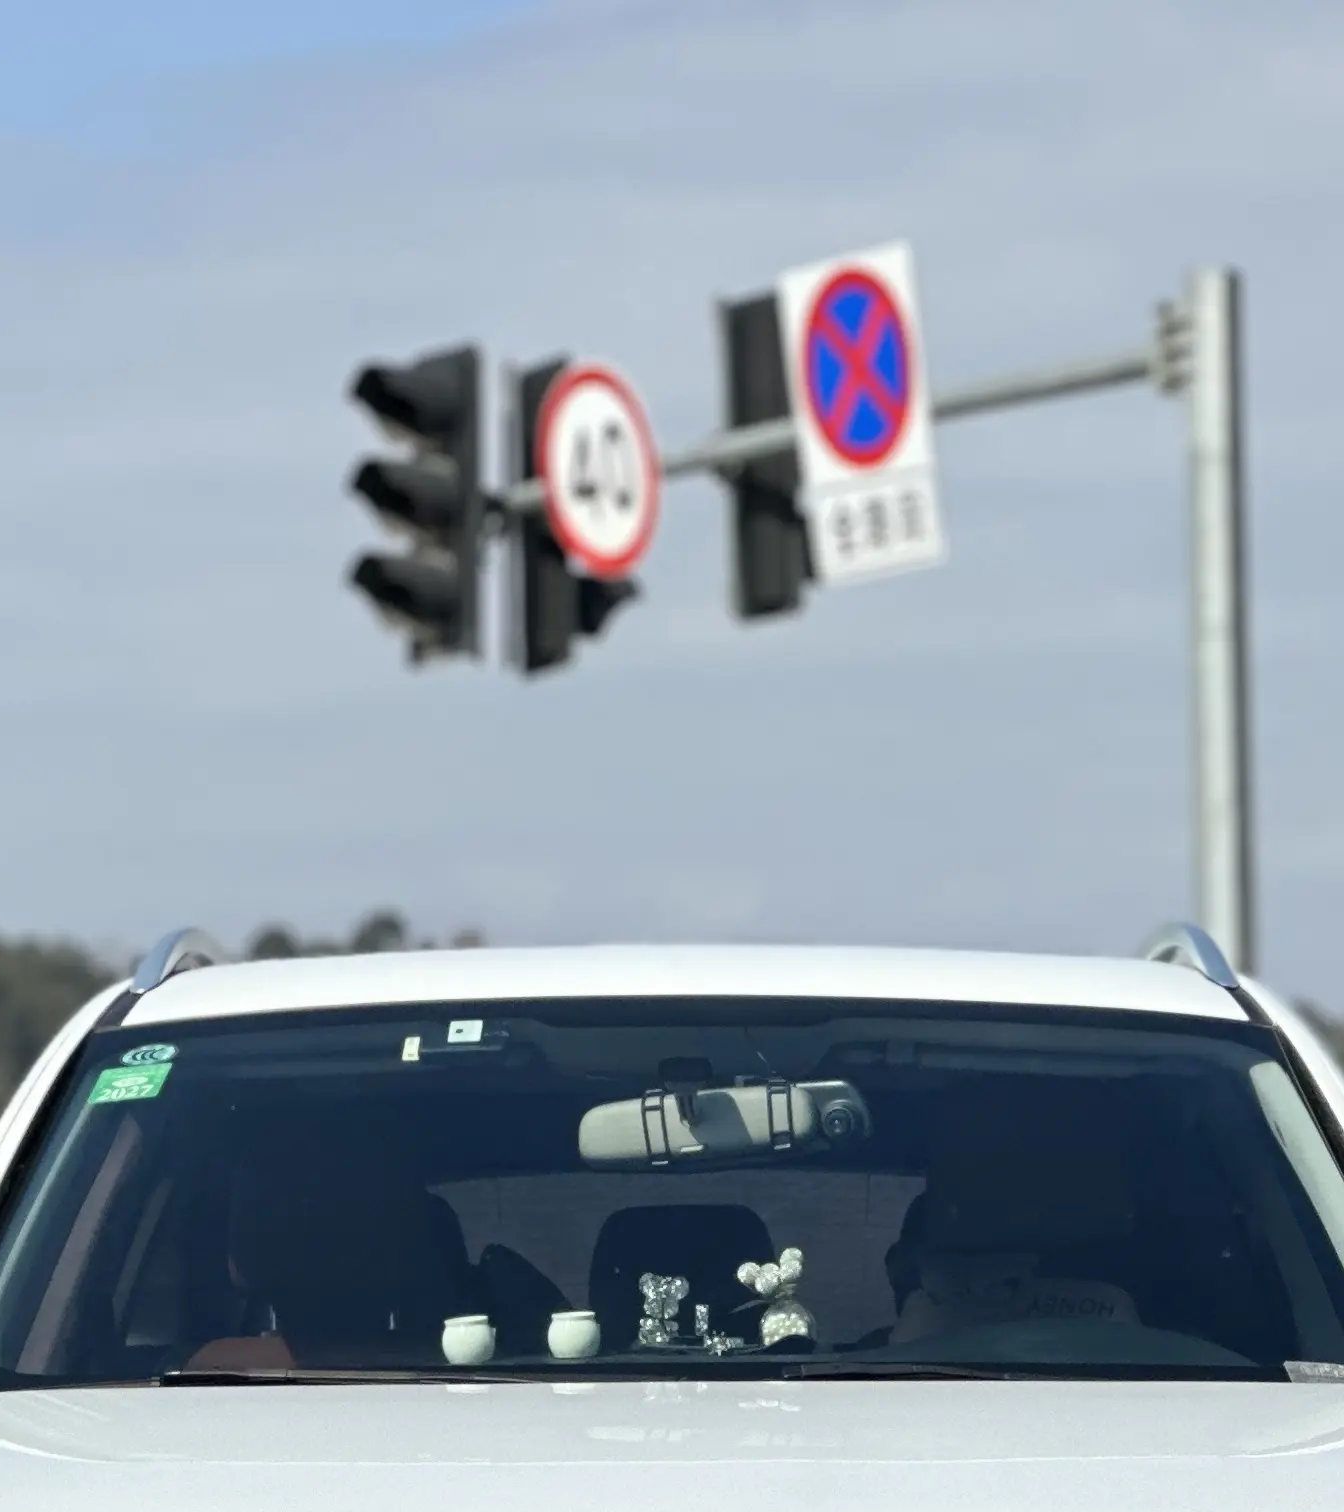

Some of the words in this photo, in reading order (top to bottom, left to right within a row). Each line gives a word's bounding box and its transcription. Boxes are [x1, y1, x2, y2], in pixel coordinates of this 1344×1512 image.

[570, 418, 638, 518] 40
[96, 1084, 154, 1101] 2027
[1025, 1292, 1116, 1318] HONEY
